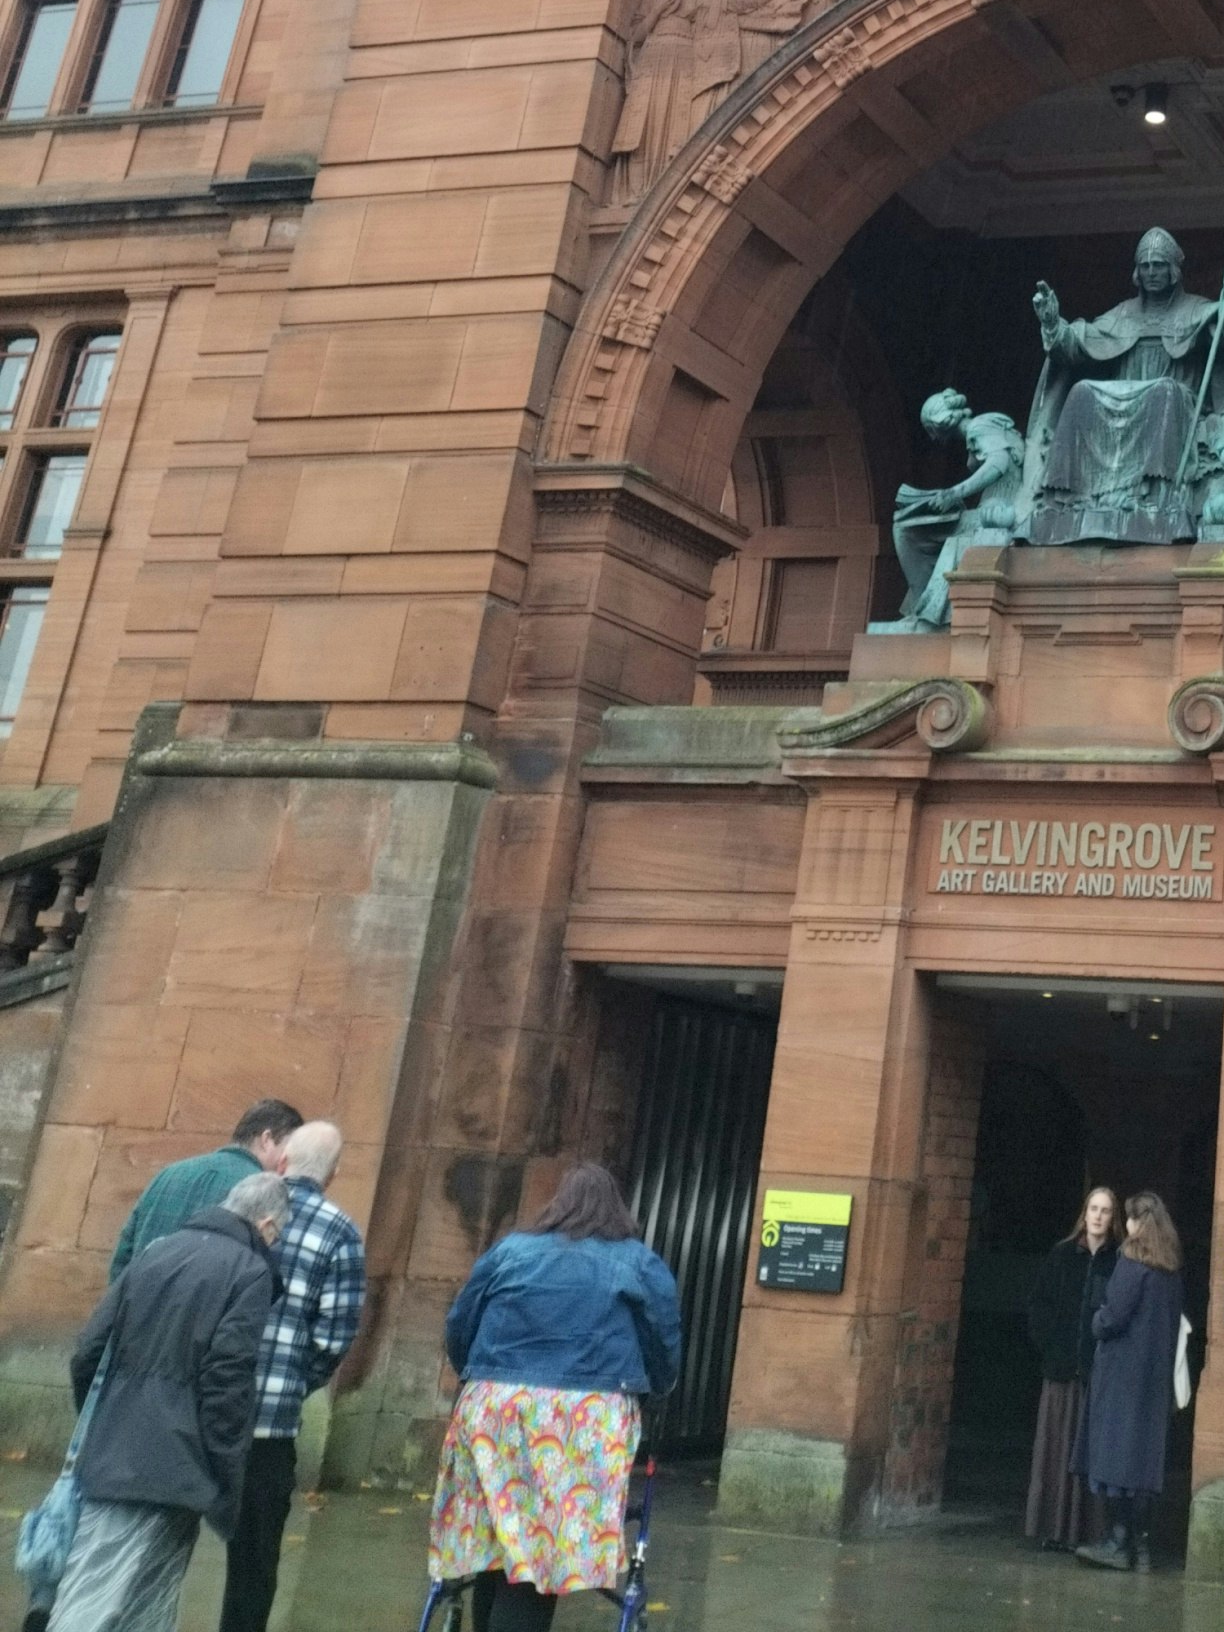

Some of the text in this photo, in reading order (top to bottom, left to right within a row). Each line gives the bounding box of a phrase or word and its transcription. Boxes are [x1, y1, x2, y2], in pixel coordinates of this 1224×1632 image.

[939, 819, 1215, 870] KELVINGROVE
[936, 869, 1213, 899] ART GALLERY AND MUSEUM
